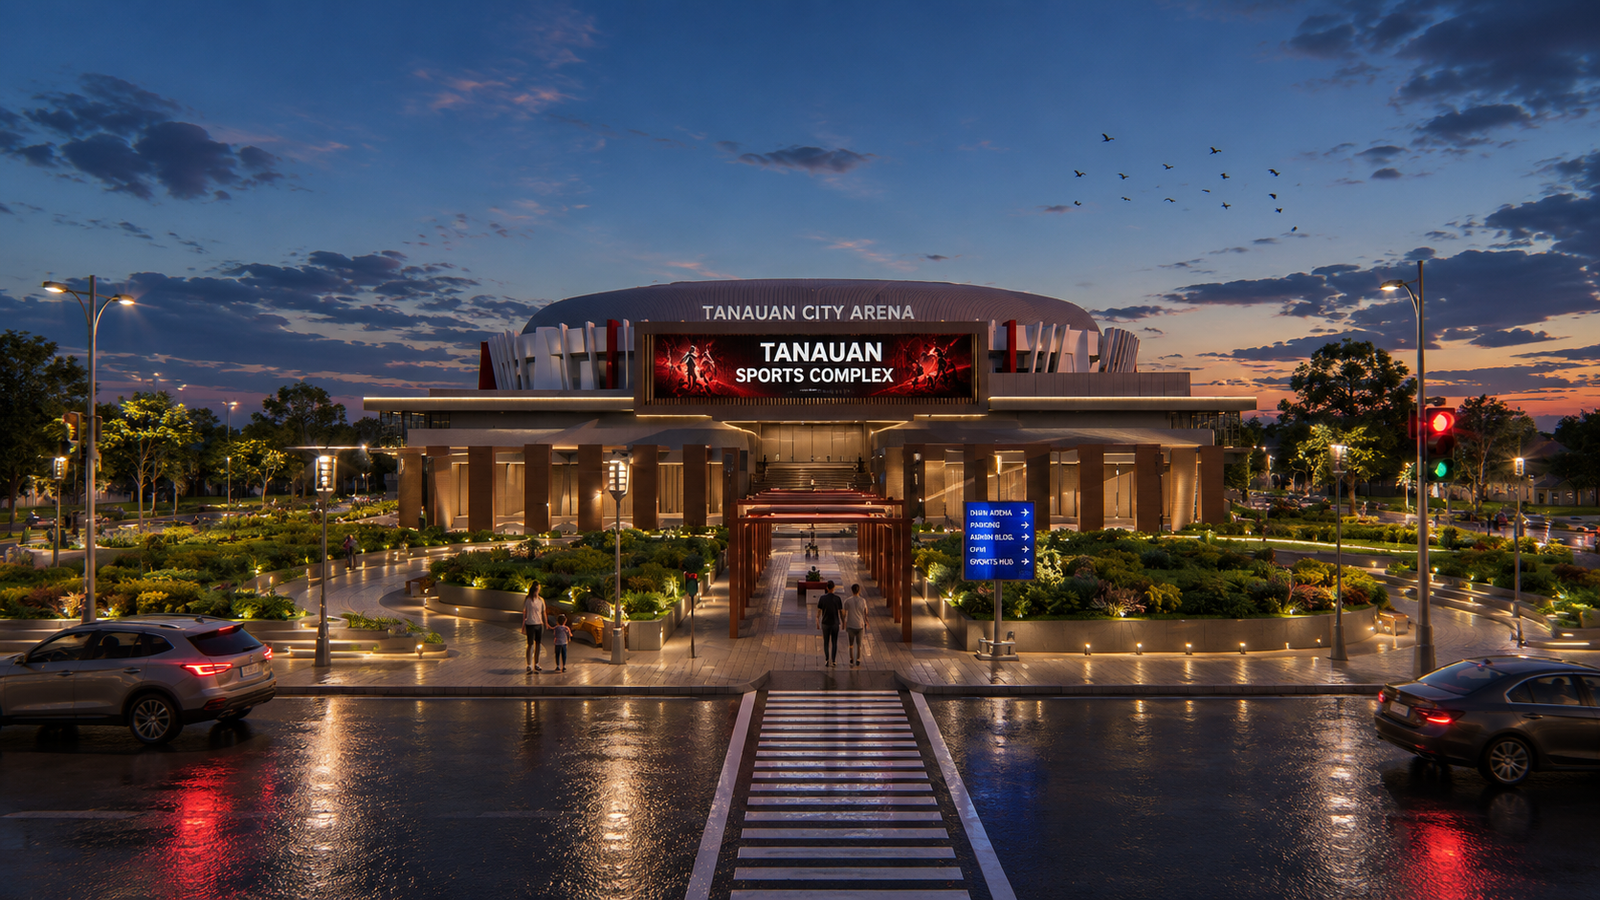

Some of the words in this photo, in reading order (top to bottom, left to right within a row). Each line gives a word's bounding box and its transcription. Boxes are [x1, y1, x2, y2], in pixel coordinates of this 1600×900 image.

[702, 305, 796, 320] TANAUAN
[802, 305, 845, 320] CITY
[850, 305, 915, 320] ARENA
[760, 342, 882, 362] TANAUAN
[735, 367, 804, 383] SPORTS
[809, 367, 894, 383] COMPLEX
